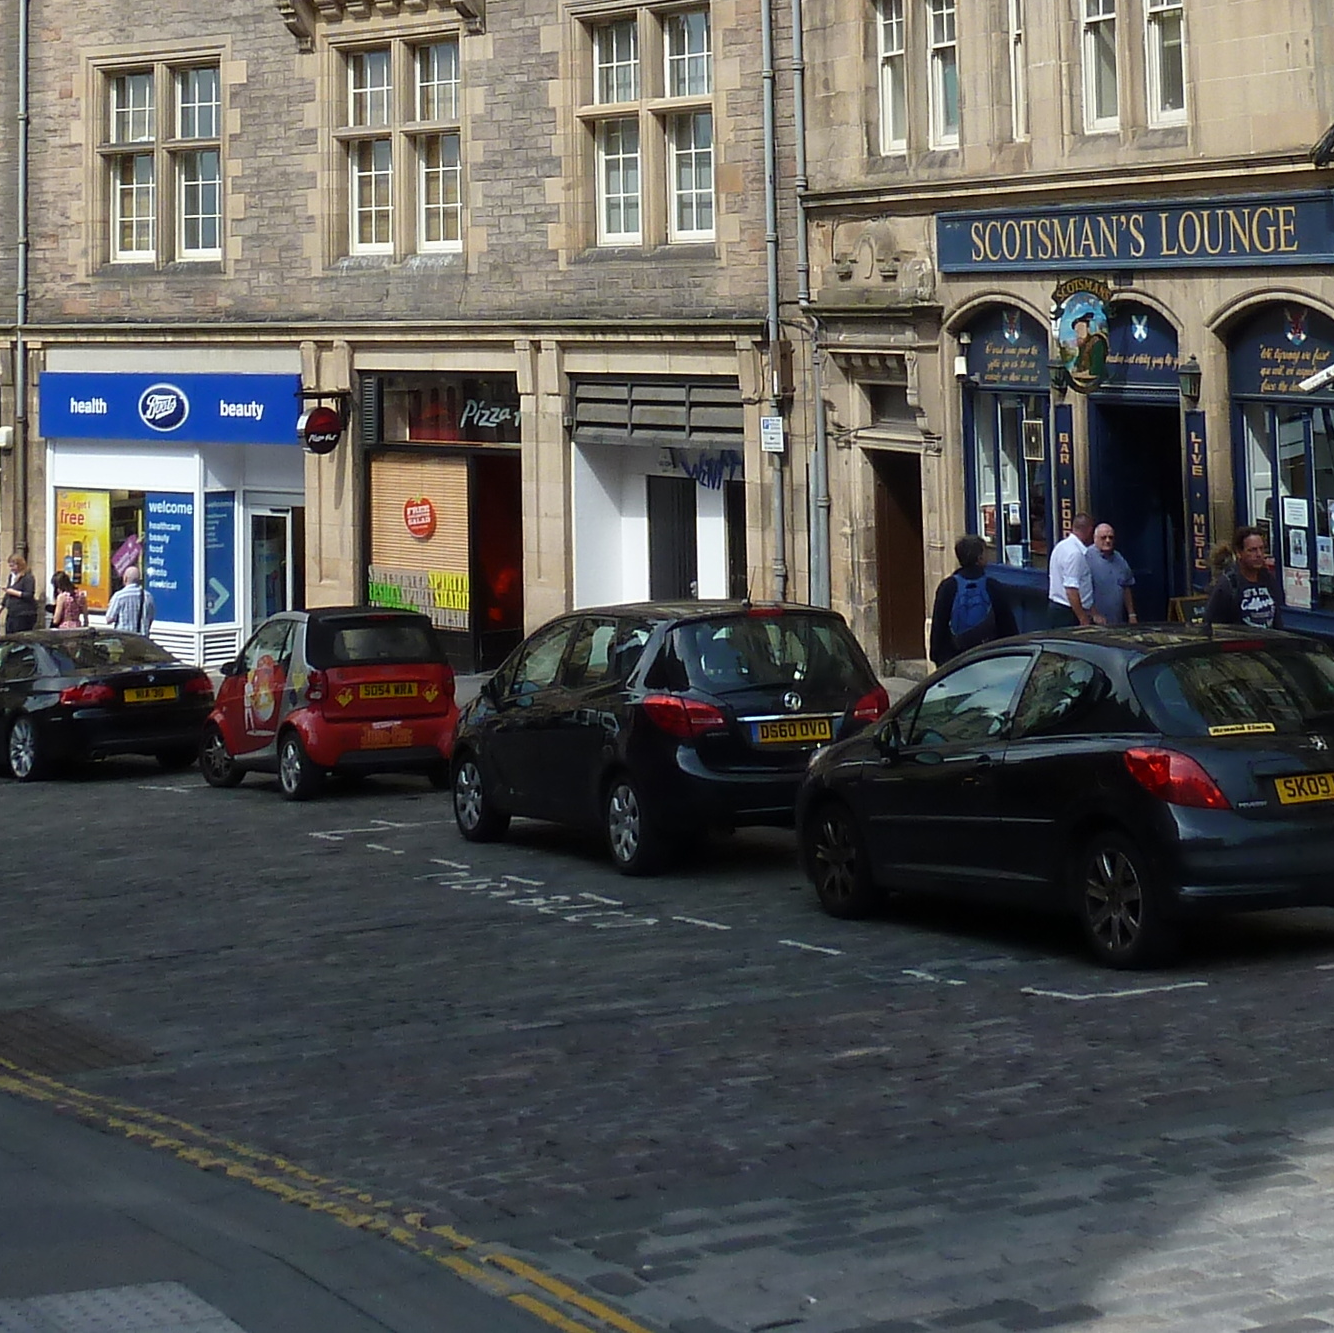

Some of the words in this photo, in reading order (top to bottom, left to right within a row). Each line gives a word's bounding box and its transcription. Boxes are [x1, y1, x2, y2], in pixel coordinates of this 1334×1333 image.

[970, 214, 1146, 261] SCOTSMAN'S
[1160, 206, 1299, 256] LOUNGE
[70, 397, 107, 414] health
[143, 394, 177, 419] Boots
[220, 400, 264, 420] beauty
[460, 400, 511, 427] Pizza
[1059, 433, 1069, 464] BAR
[1191, 432, 1203, 476] LIVE
[60, 509, 84, 526] free
[148, 500, 193, 515] welcome
[1193, 513, 1206, 569] MUSIC
[1283, 775, 1330, 798] SK09
